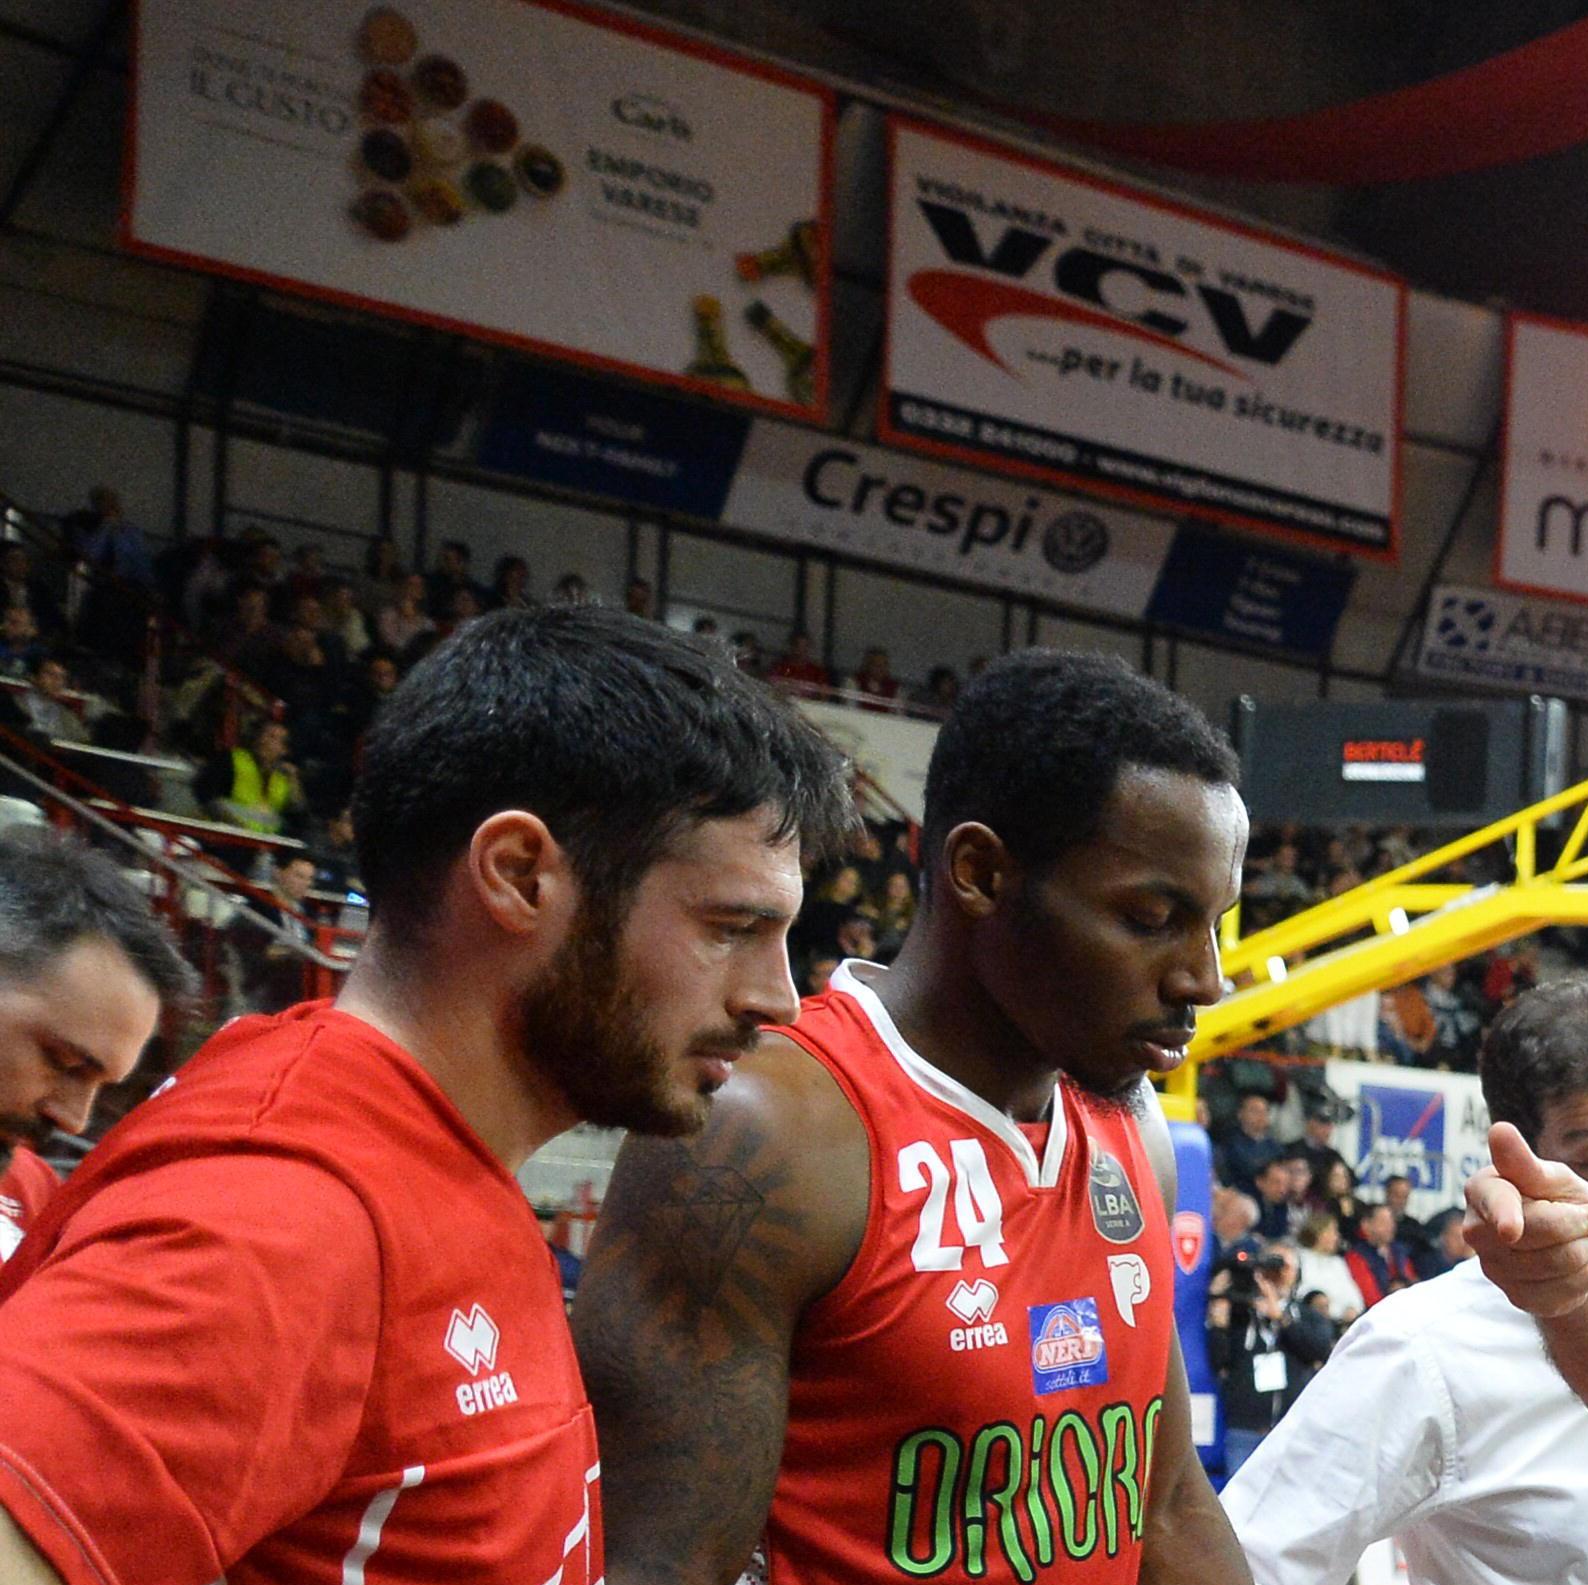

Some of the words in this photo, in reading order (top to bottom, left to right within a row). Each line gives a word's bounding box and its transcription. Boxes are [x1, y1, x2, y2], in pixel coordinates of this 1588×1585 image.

[915, 176, 1067, 237] VIGILANZA
[916, 200, 1313, 366] VCV
[1130, 356, 1162, 393] la
[1170, 374, 1226, 410] tua
[1232, 394, 1386, 454] sicurezza
[802, 449, 1039, 557] Crespi
[898, 1137, 1010, 1273] 24
[1094, 1191, 1135, 1217] LBA
[949, 1321, 1009, 1352] errea
[456, 1370, 518, 1416] errea
